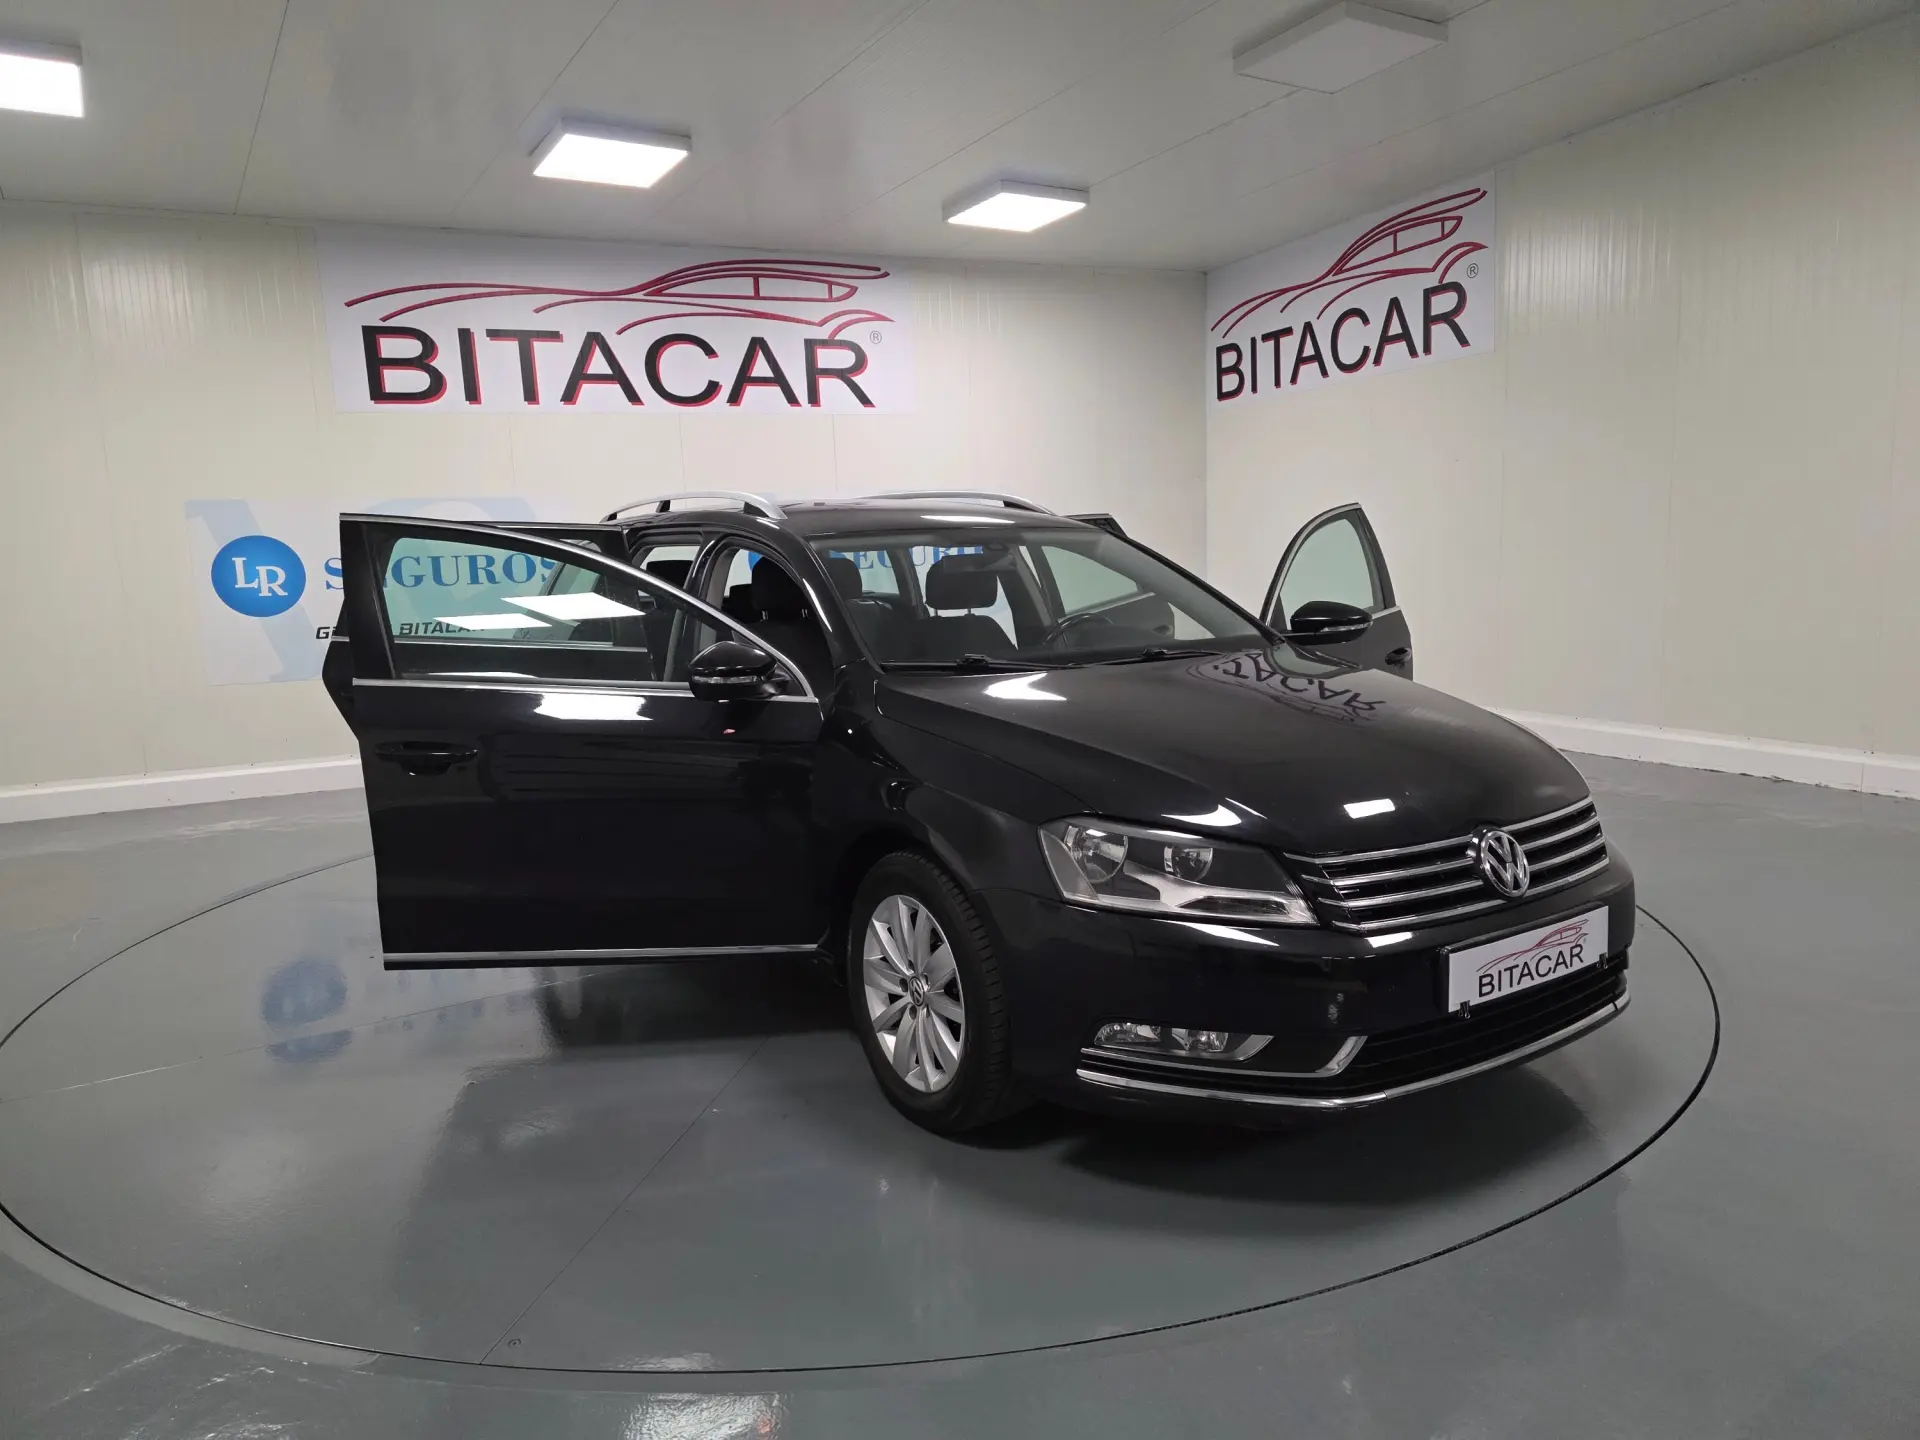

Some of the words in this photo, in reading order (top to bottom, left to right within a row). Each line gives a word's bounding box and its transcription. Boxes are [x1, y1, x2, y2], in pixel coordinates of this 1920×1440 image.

[361, 324, 877, 408] BITACAR
[1216, 281, 1471, 401] BITACAR
[231, 557, 288, 597] LR
[324, 551, 557, 590] SGURO
[1478, 943, 1584, 998] BITACAR
